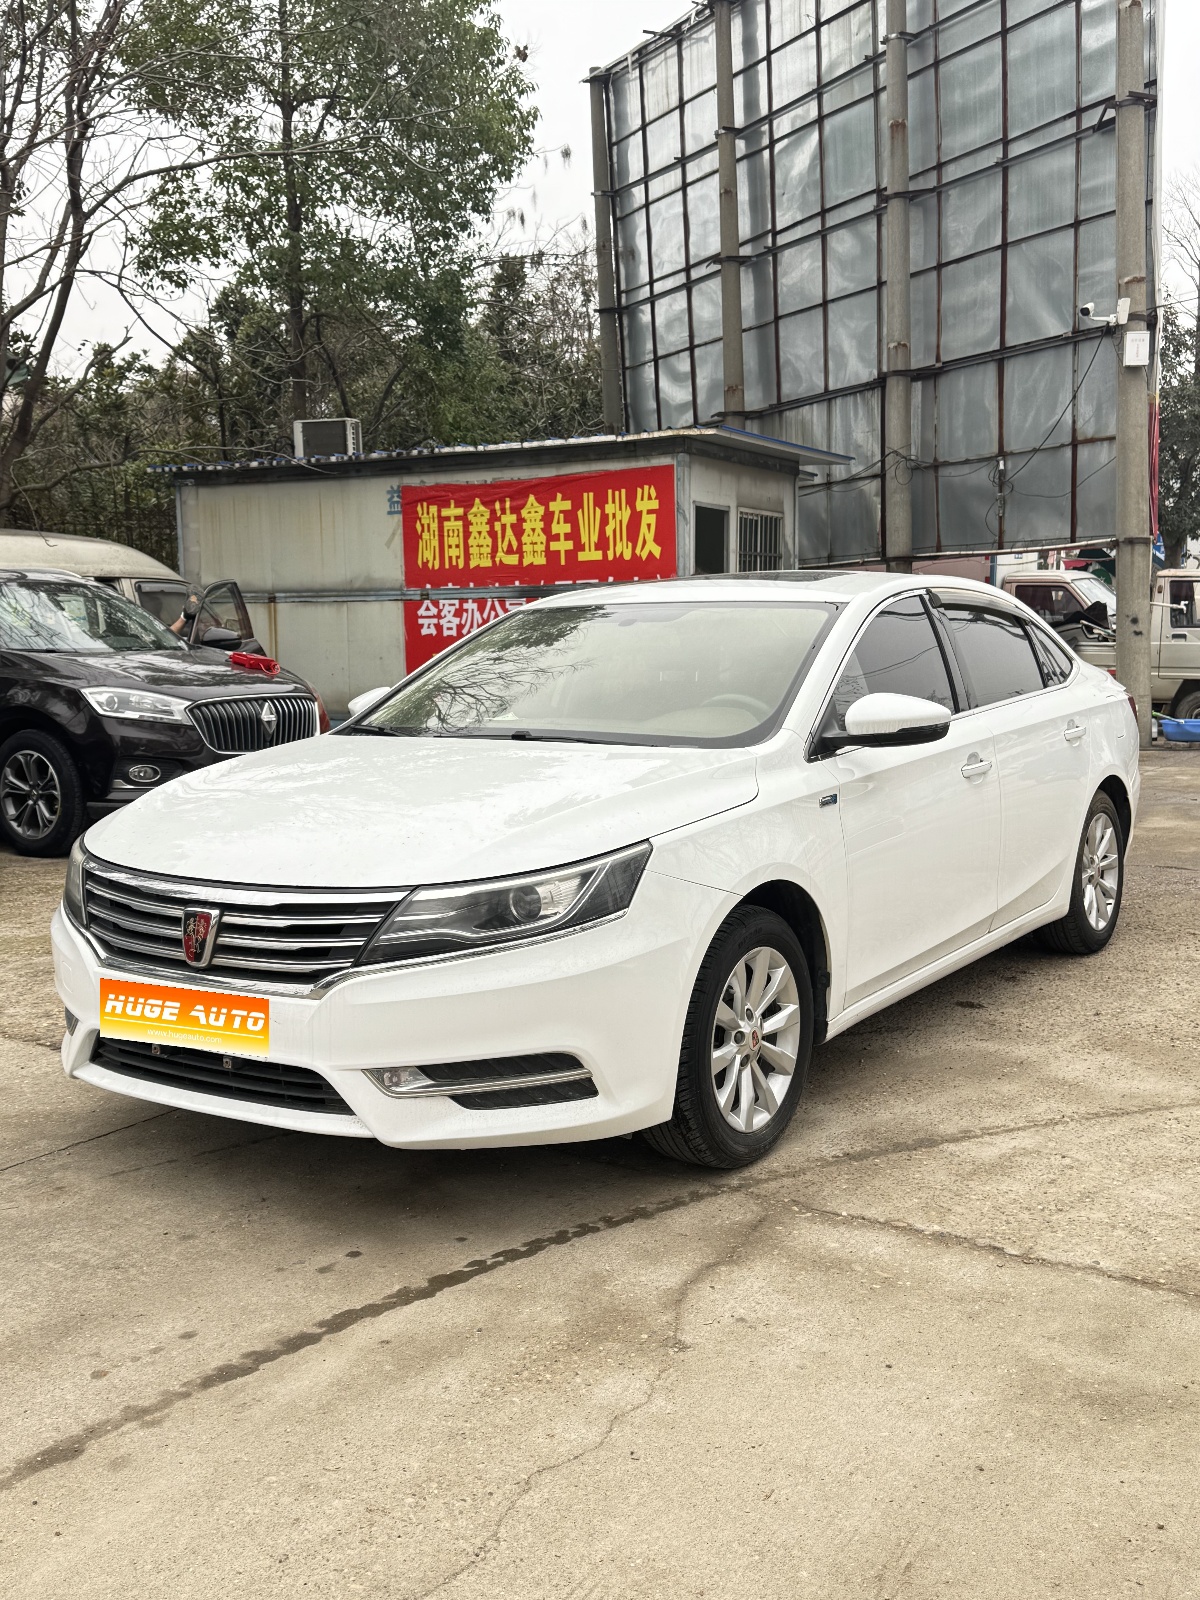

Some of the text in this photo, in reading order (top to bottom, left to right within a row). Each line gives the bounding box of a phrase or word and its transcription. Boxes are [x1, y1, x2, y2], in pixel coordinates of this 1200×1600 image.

[416, 485, 662, 570] 湖南鑫达鑫车业批发
